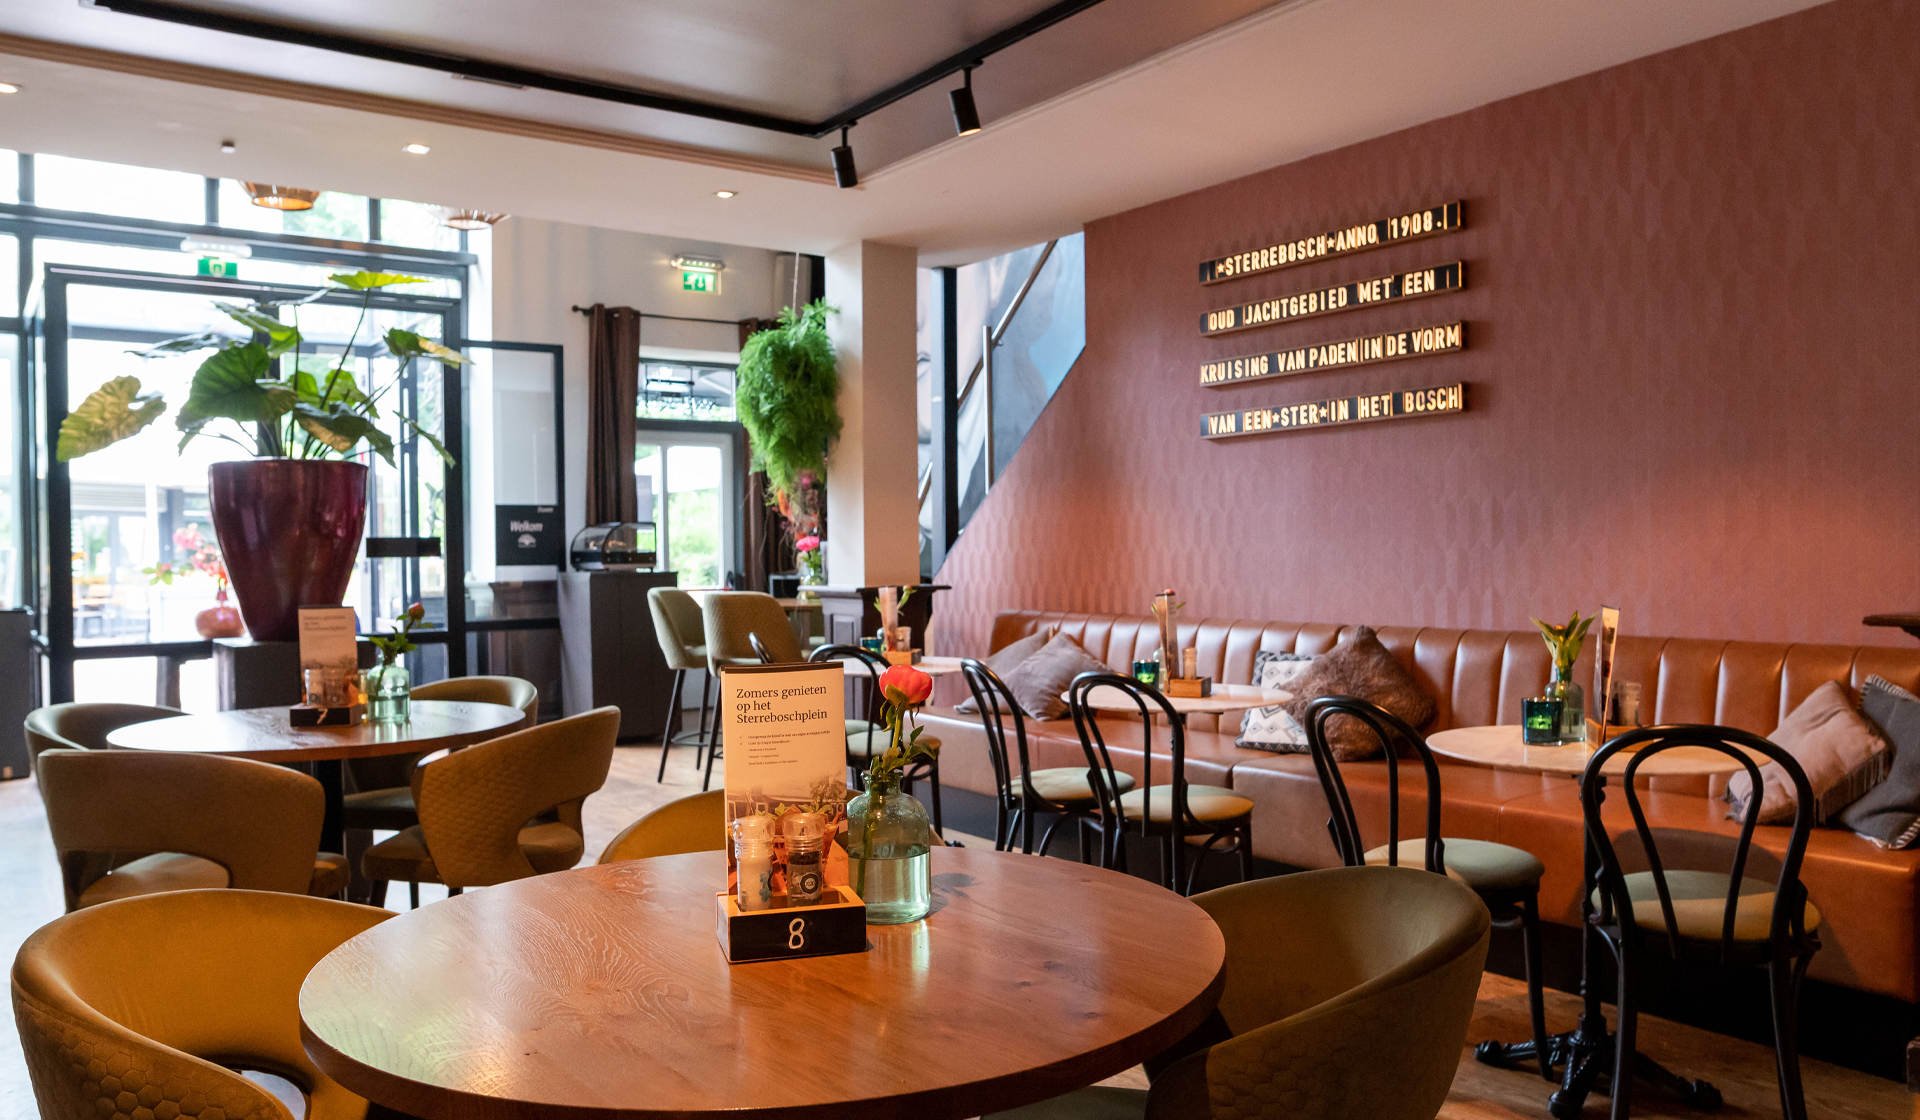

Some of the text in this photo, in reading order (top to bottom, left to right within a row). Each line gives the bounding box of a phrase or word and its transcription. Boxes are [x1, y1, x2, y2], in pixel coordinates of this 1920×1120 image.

[1336, 223, 1377, 251] ANNO
[1209, 269, 1434, 331] OUD JACHTGEBIED MET EEN
[1200, 355, 1269, 383] KRUISING
[1364, 337, 1381, 359] IN
[1387, 333, 1407, 356] DE
[1412, 324, 1459, 353] VORM
[1210, 413, 1236, 435] VAN
[1331, 399, 1348, 421] IN
[1360, 394, 1390, 419] HET
[1405, 386, 1458, 413] BOSCH
[510, 520, 543, 532] Welkom
[736, 685, 827, 700] Zomers genieten
[317, 708, 328, 725] 7
[736, 700, 771, 713] op het
[736, 709, 828, 723] Sterreboschplein
[788, 917, 805, 949] 8
